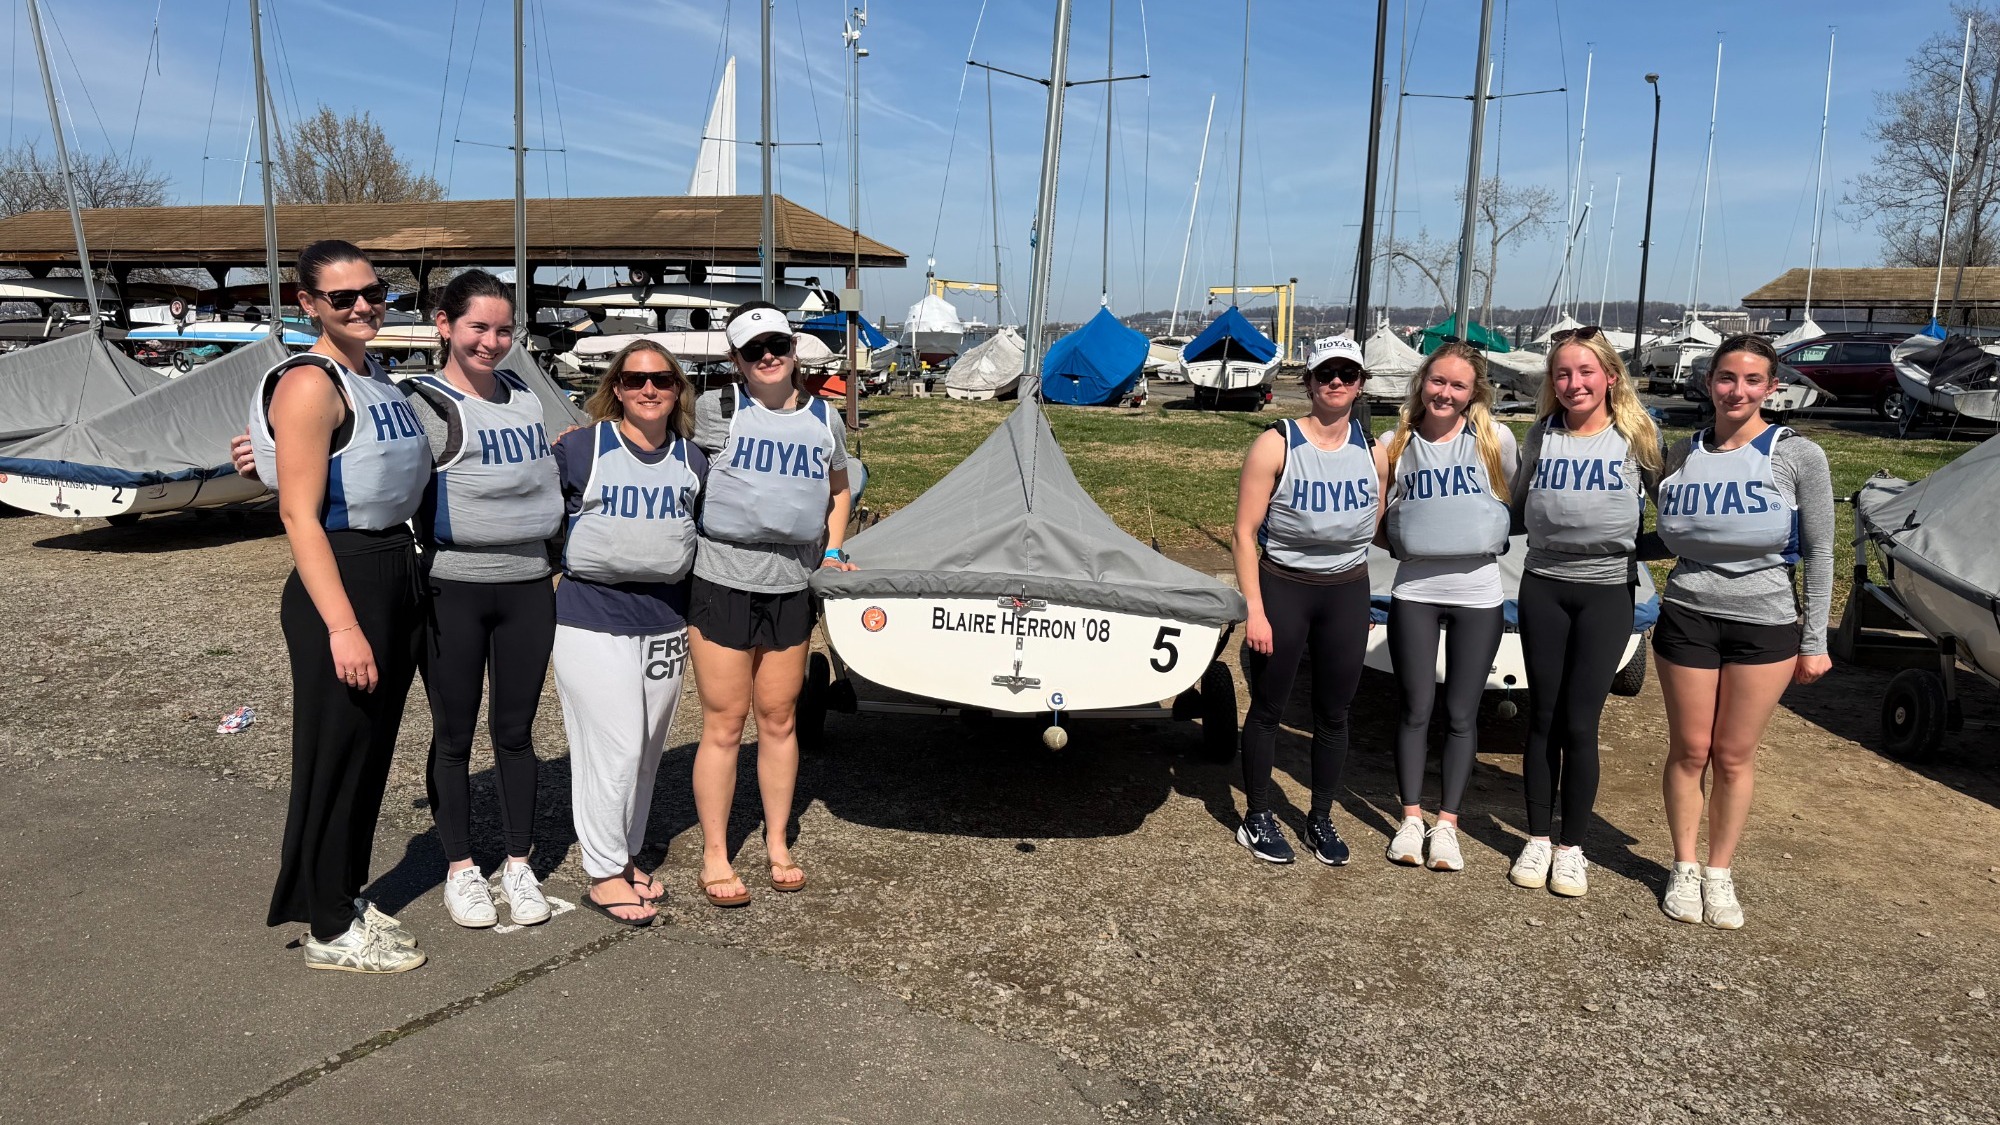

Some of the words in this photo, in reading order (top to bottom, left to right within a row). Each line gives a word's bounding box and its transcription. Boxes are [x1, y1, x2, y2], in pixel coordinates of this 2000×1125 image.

[751, 312, 762, 321] G
[1319, 340, 1353, 349] HOYAS
[367, 400, 425, 441] HOY
[477, 422, 553, 465] HOYA
[731, 436, 825, 480] HOYAS
[1403, 465, 1481, 501] HOYAS
[1533, 458, 1624, 491] HOYAS
[111, 485, 123, 504] 2
[1289, 477, 1370, 513] HOYAS
[932, 606, 997, 634] BLAIRE
[1000, 612, 1076, 640] HERRON
[1081, 617, 1111, 642] '08
[647, 632, 689, 660] FRE
[1149, 626, 1182, 673] 5
[645, 652, 688, 680] CIT
[1051, 692, 1064, 705] G
